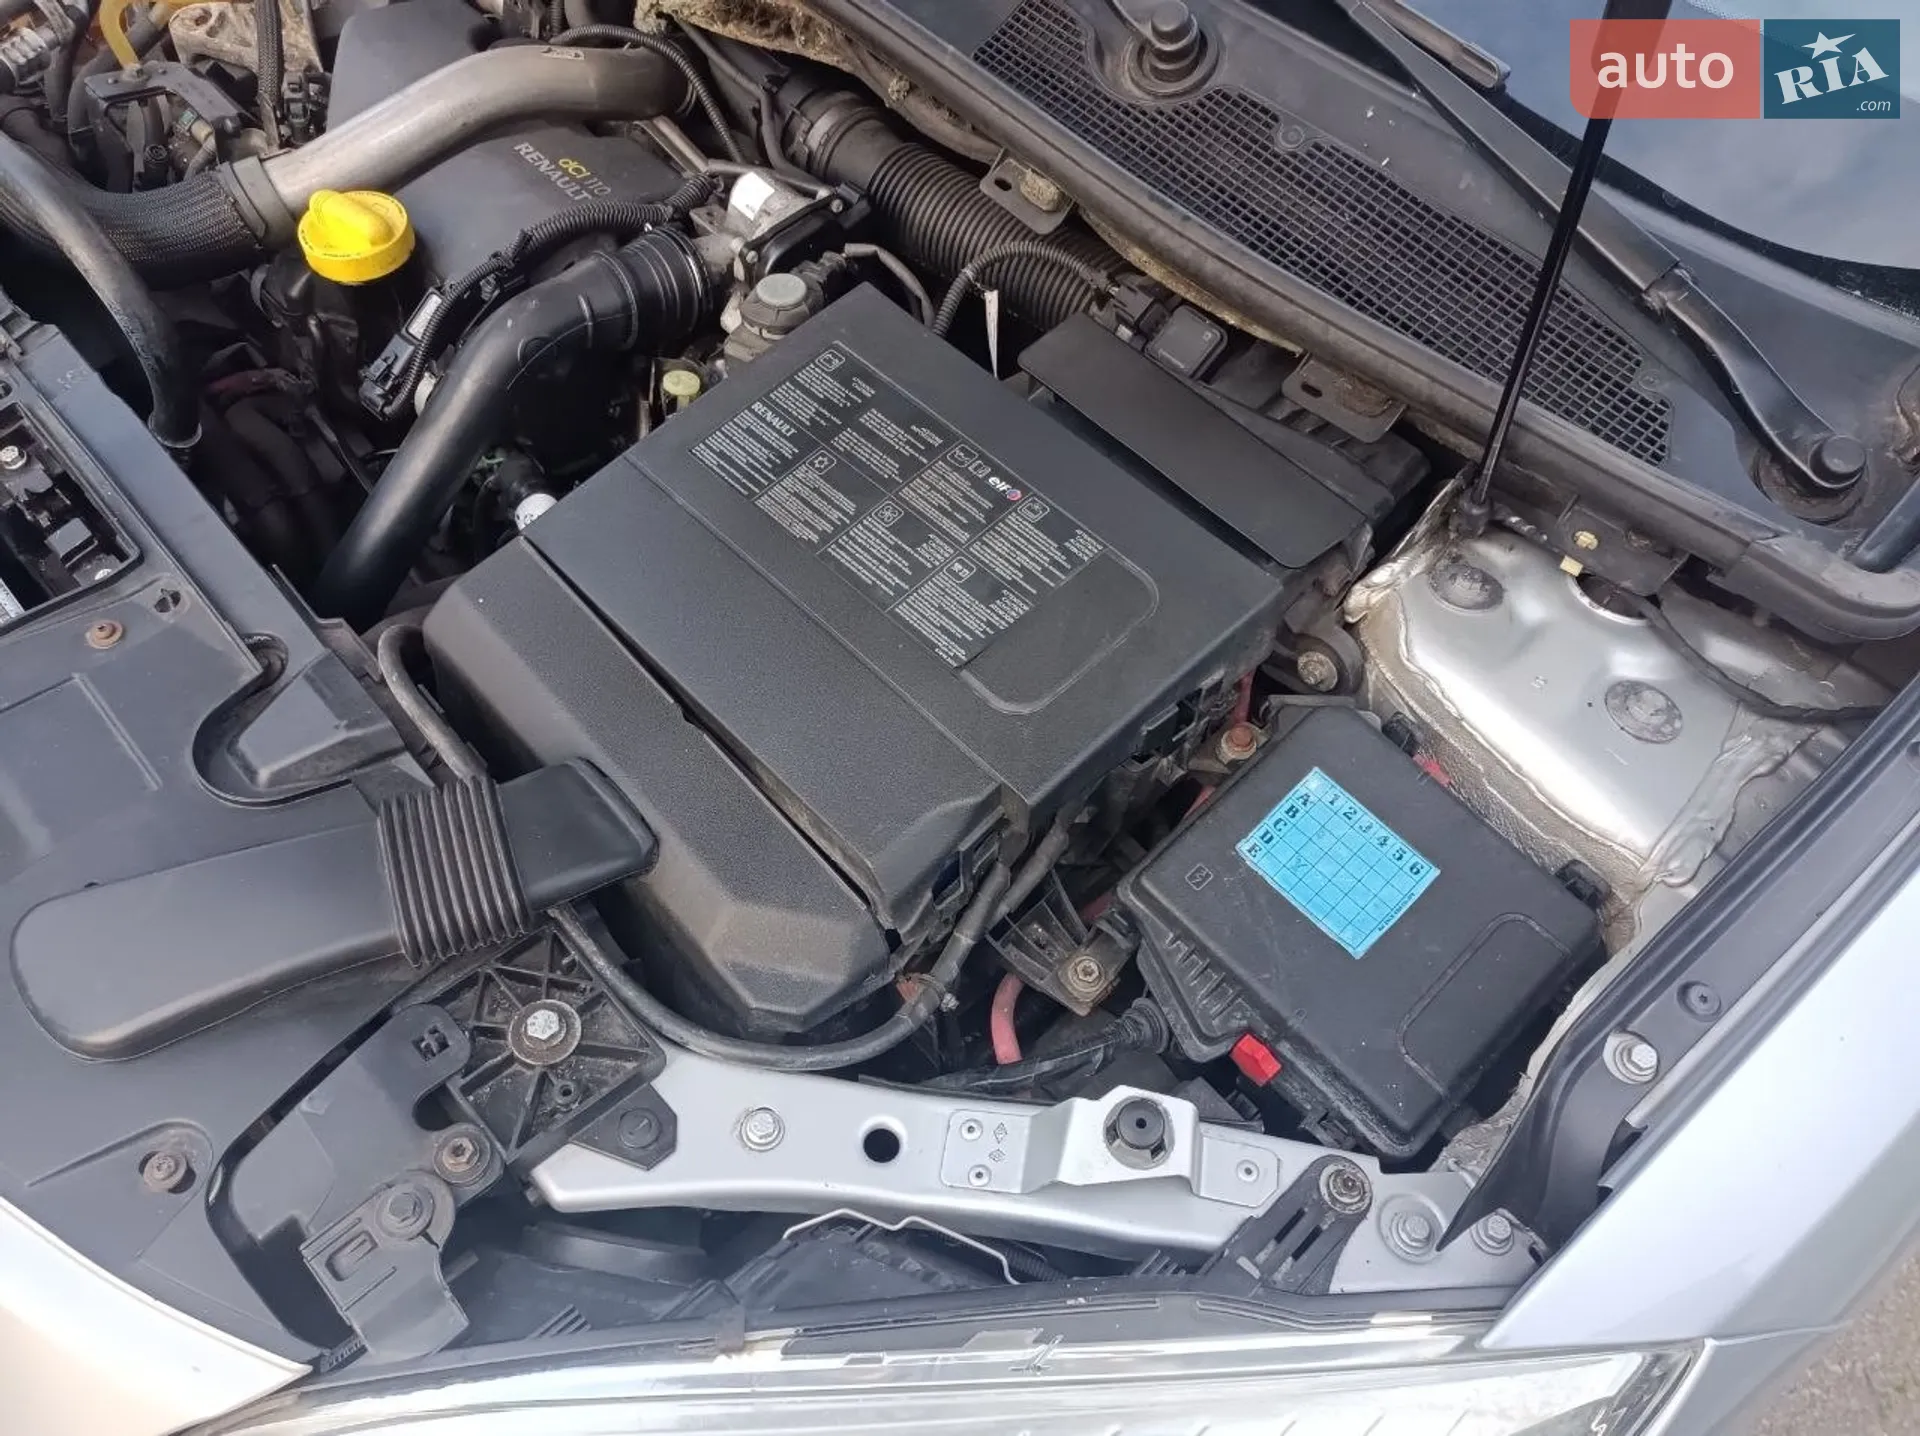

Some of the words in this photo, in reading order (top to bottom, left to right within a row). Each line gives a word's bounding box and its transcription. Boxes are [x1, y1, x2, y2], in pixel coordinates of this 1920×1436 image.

[514, 142, 592, 200] RENAULT
[751, 401, 798, 437] RENAULT
[1296, 792, 1313, 807] A
[1284, 805, 1299, 819] B
[1273, 817, 1288, 832] C
[1259, 830, 1274, 845] D
[1328, 793, 1339, 806] 1
[1343, 807, 1357, 820] 2
[1359, 822, 1374, 834] 3
[1377, 835, 1390, 848] 4
[1392, 848, 1407, 861] 5
[1409, 861, 1424, 875] 6
[1247, 844, 1262, 858] E
